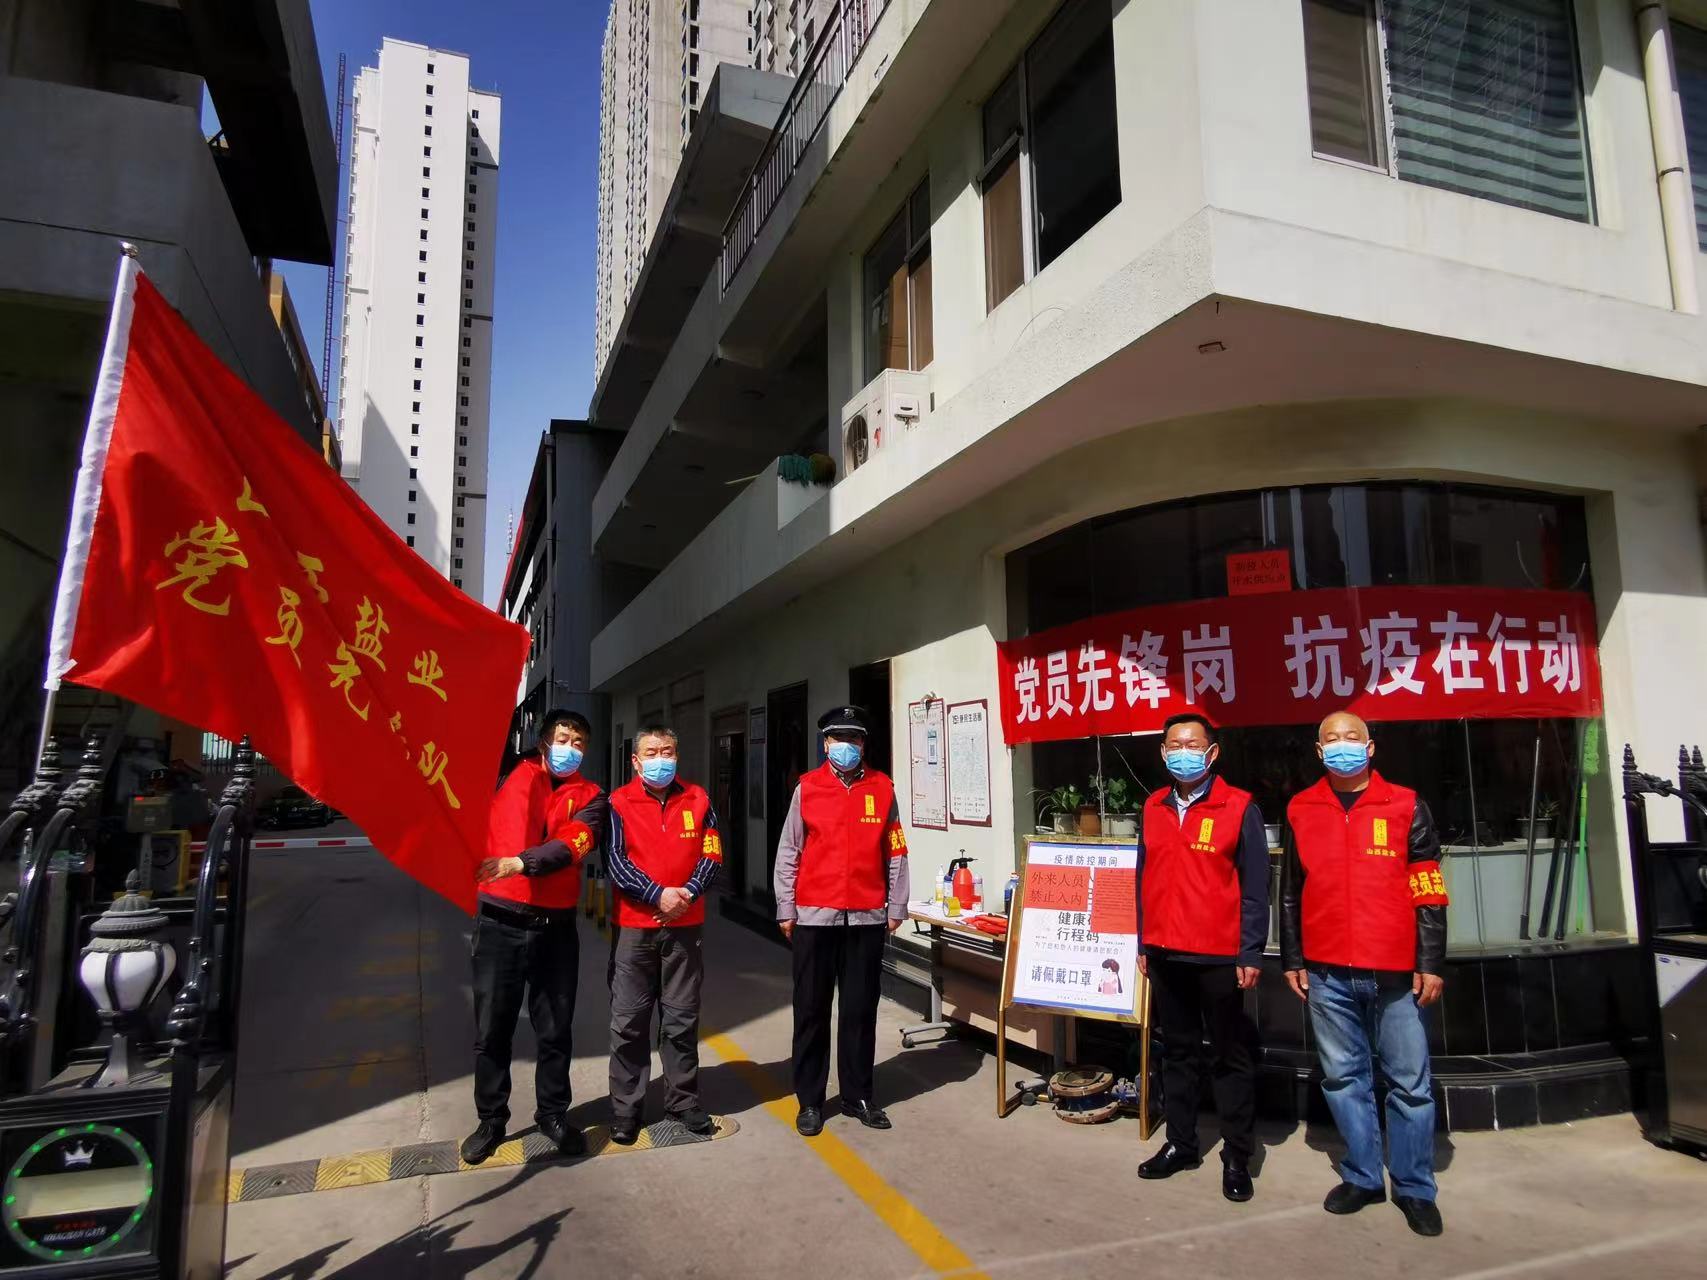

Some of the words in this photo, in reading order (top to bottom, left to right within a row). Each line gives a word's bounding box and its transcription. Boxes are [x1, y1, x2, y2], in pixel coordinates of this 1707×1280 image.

[237, 476, 447, 702] 盐业
[1014, 624, 1237, 725] 党员先锋岗
[1284, 610, 1583, 700] 抗疫在行动
[1054, 855, 1118, 867] 疫情防控期间
[1031, 872, 1085, 888] 外来人员
[1030, 890, 1082, 906] 禁止入内
[1056, 927, 1099, 944] 行程码
[1031, 965, 1092, 987] 请佩戴口罩
